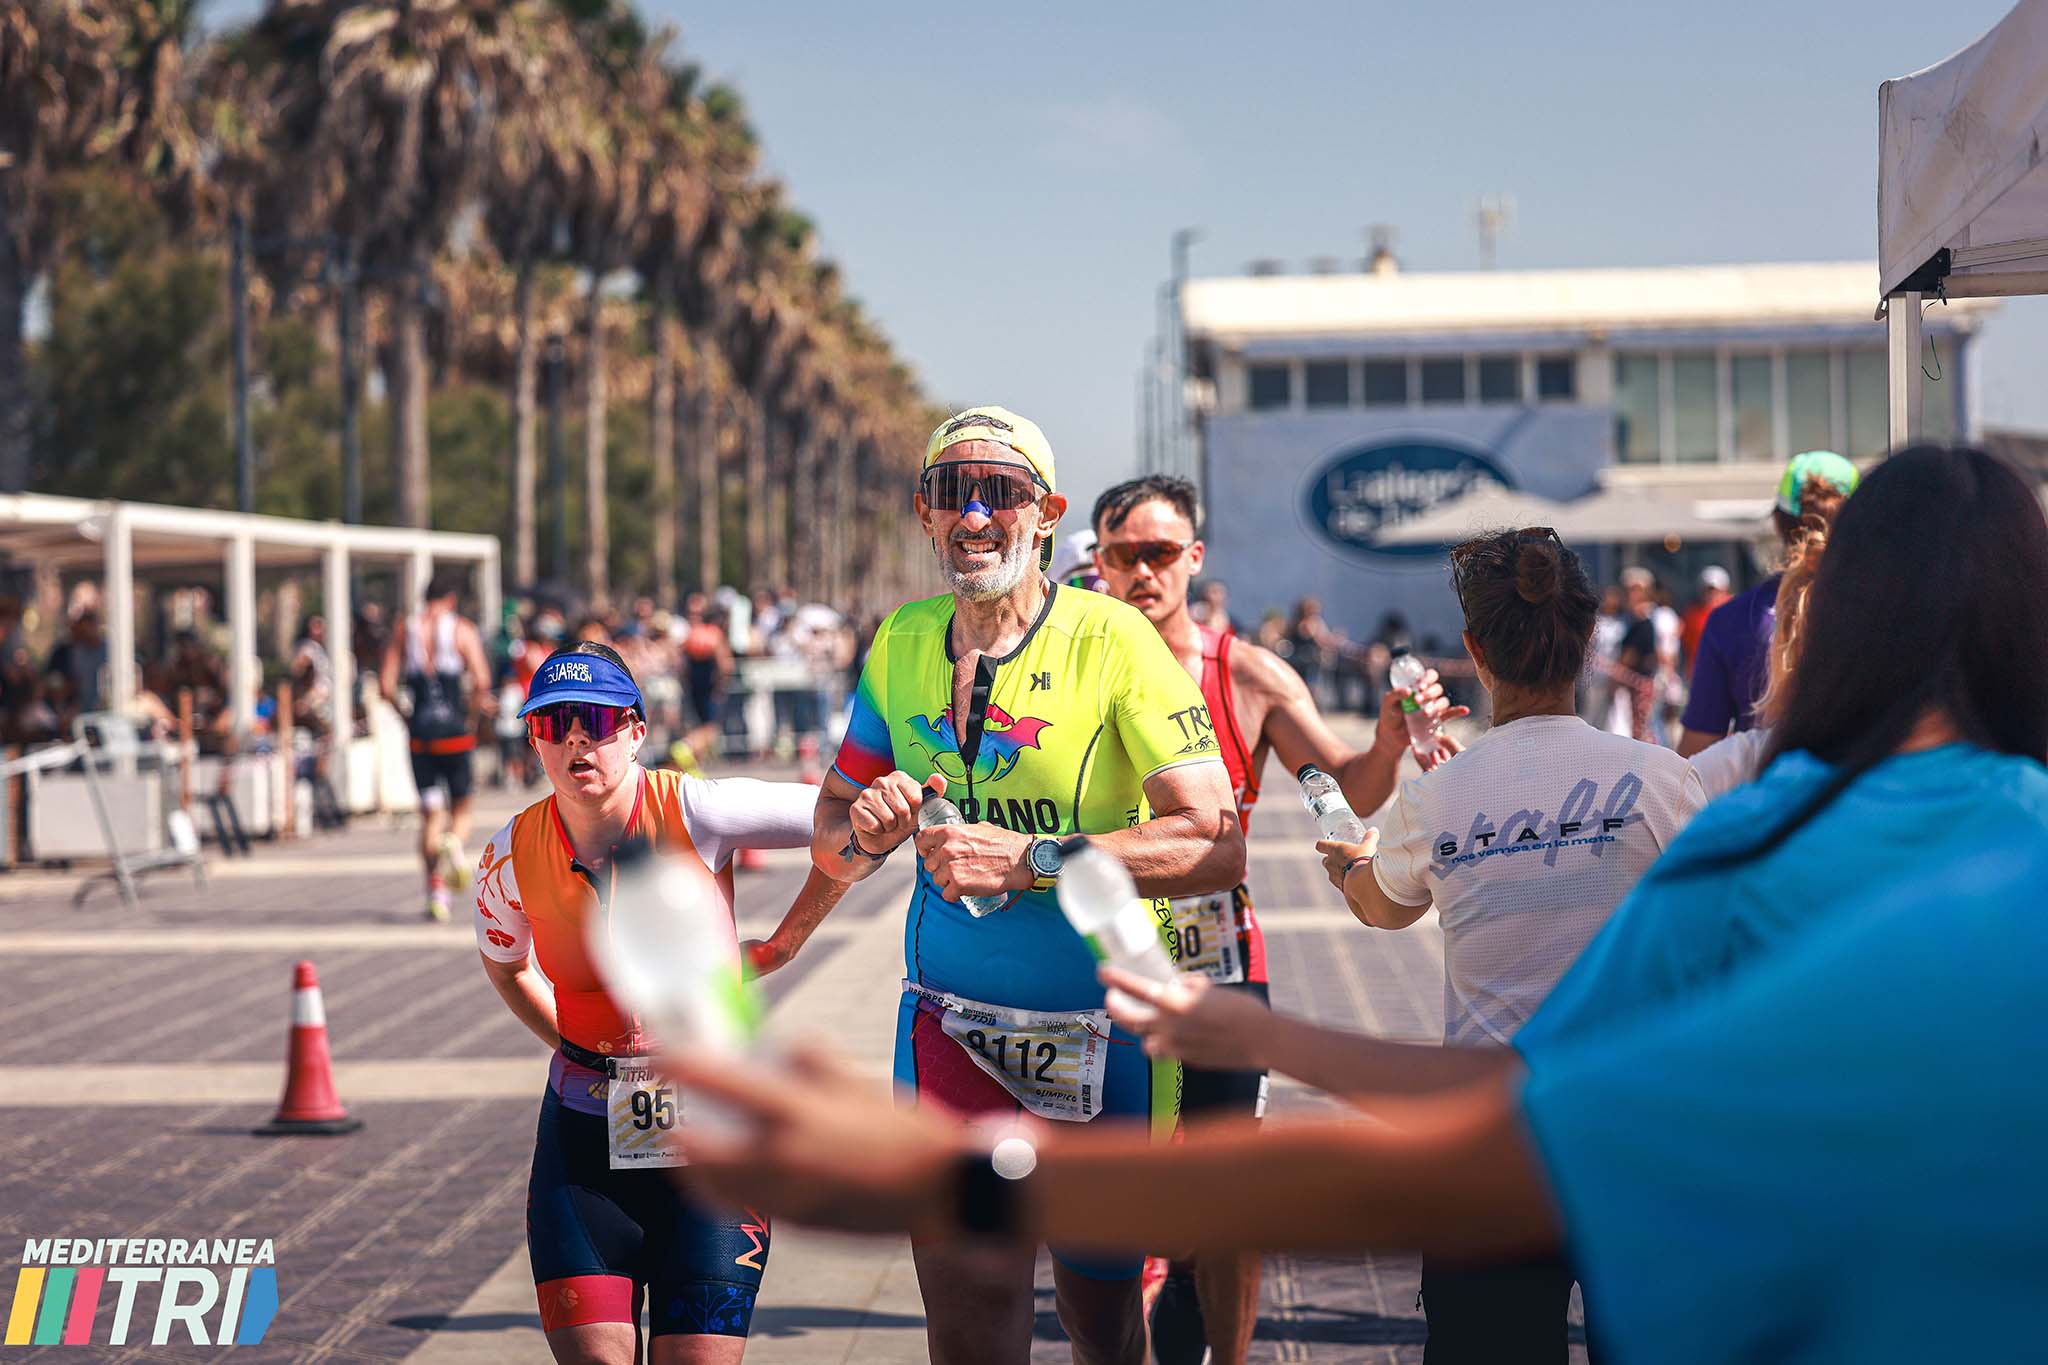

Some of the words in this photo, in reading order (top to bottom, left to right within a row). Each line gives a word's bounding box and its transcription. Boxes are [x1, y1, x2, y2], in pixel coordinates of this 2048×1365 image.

[944, 797, 1060, 835] RANO
[1439, 818, 1625, 856] STAFF
[1451, 852, 1476, 864] nos
[1478, 844, 1530, 858] vemos
[1532, 841, 1552, 852] en
[1554, 838, 1569, 848] la
[1570, 834, 1615, 846] meta
[1149, 897, 1180, 962] REVOL
